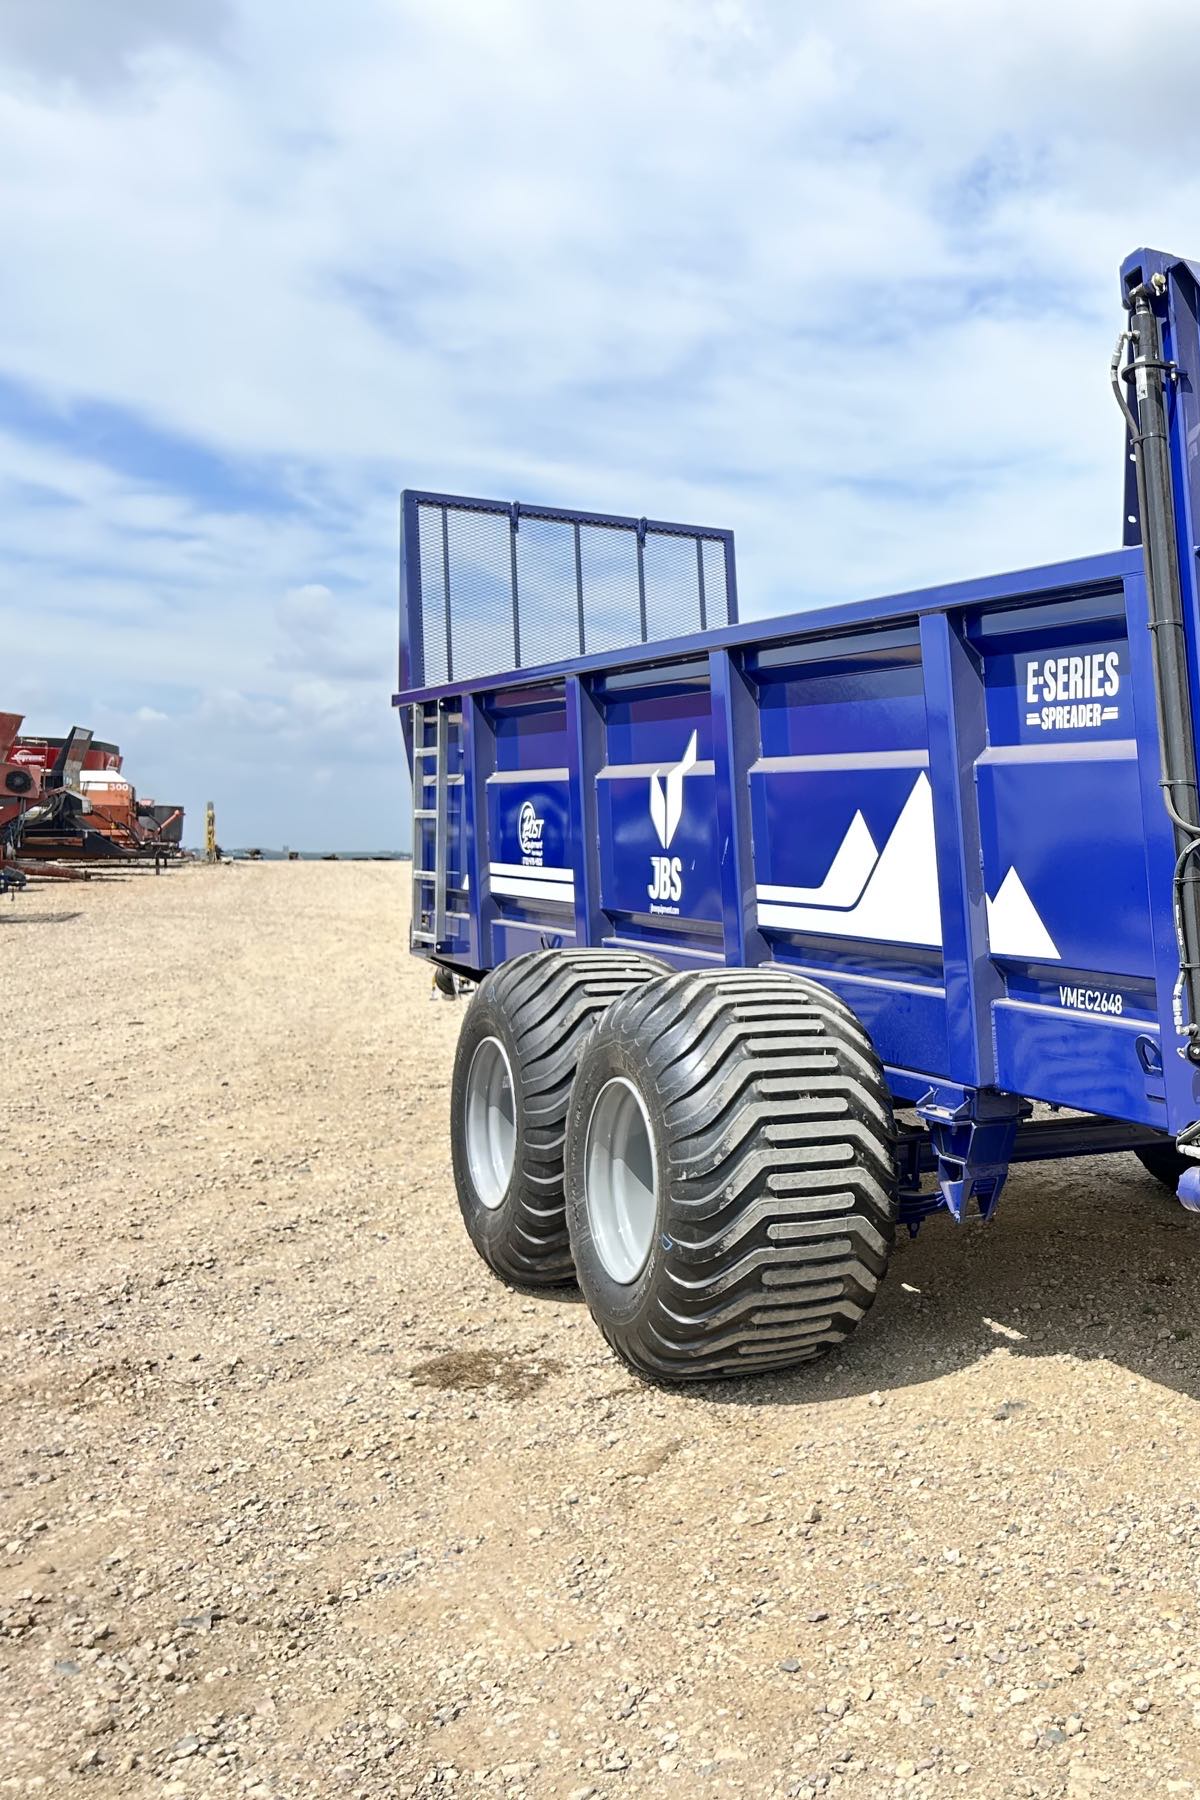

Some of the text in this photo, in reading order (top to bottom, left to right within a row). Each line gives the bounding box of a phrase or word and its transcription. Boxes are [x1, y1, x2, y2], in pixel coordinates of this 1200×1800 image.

[1026, 651, 1120, 704] E-SERIES
[1040, 703, 1102, 731] SPREADER
[109, 783, 129, 792] 300
[647, 856, 682, 902] JBS
[1058, 985, 1123, 1015] VMEC2648
